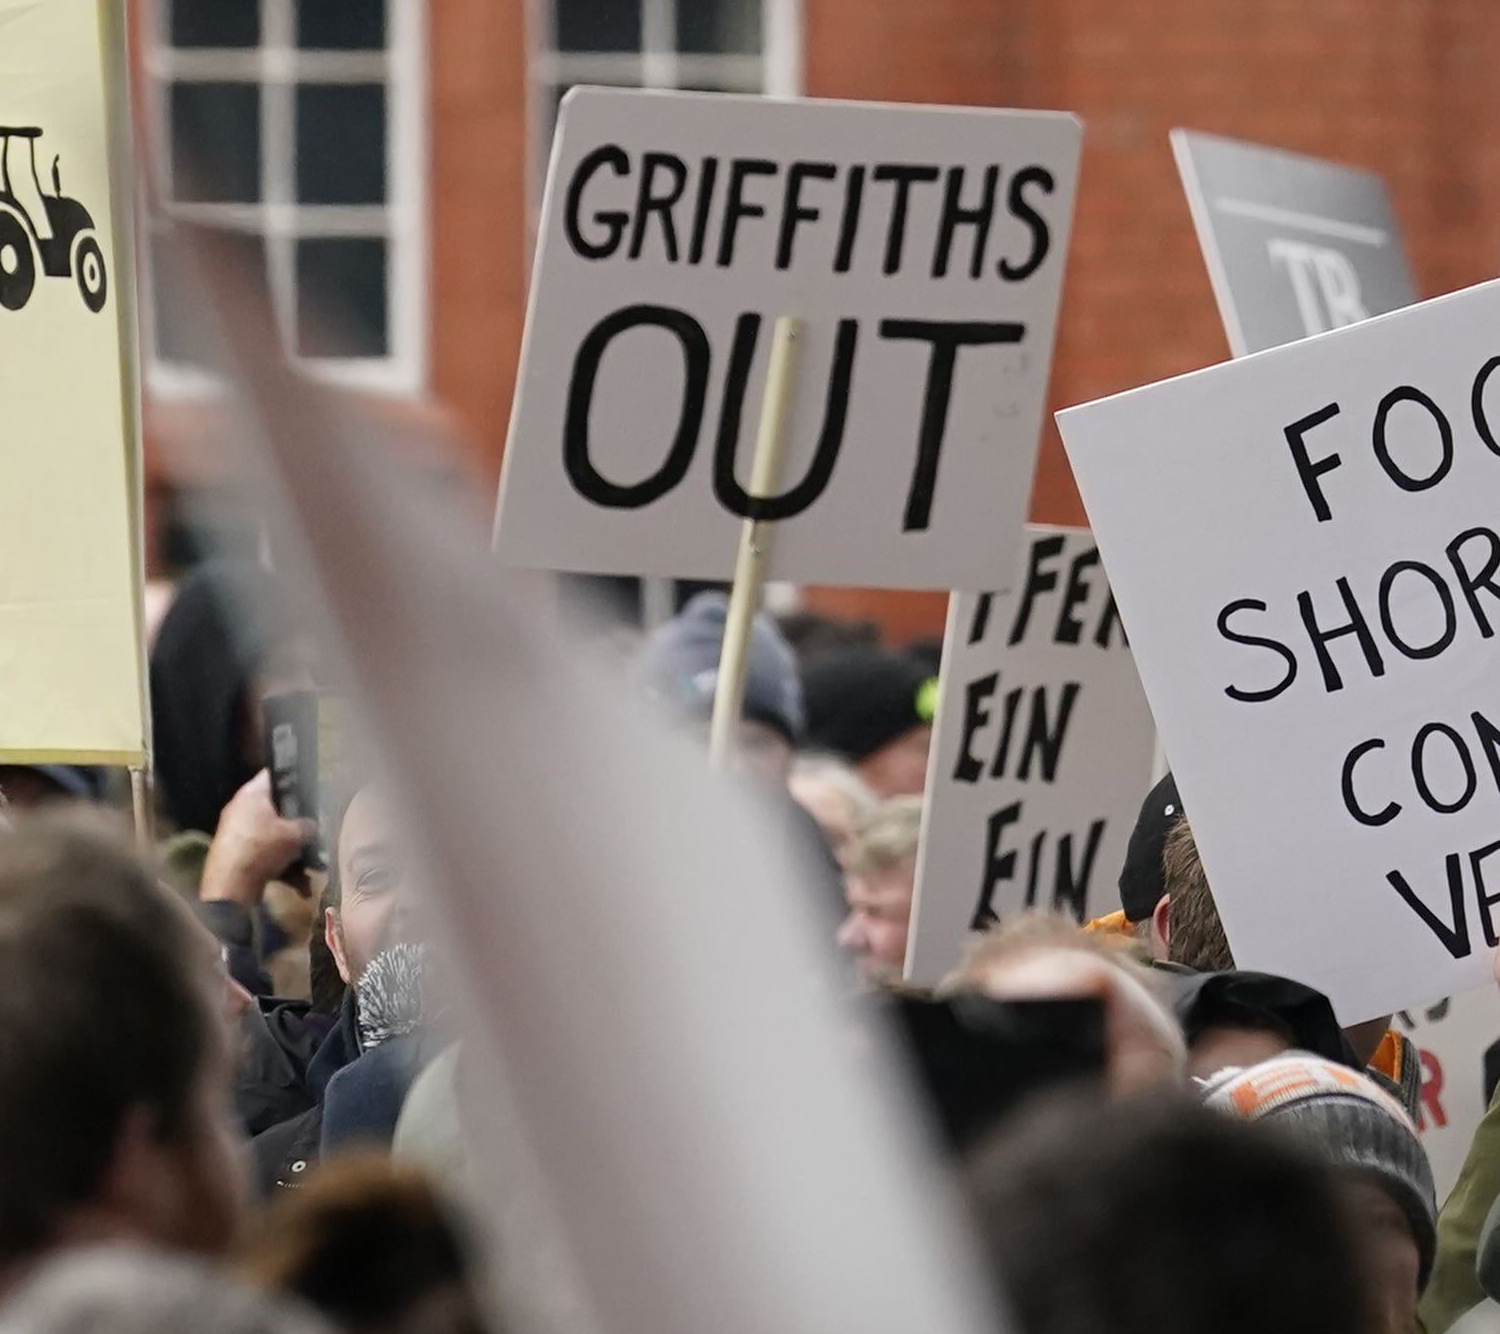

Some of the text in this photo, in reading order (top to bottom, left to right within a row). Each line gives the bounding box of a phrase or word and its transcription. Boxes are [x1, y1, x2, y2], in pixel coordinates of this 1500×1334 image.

[564, 144, 1055, 282] GRIFFITHS
[562, 303, 1026, 533] OUT
[952, 671, 1082, 785] EIN
[969, 800, 1107, 932] EIN
